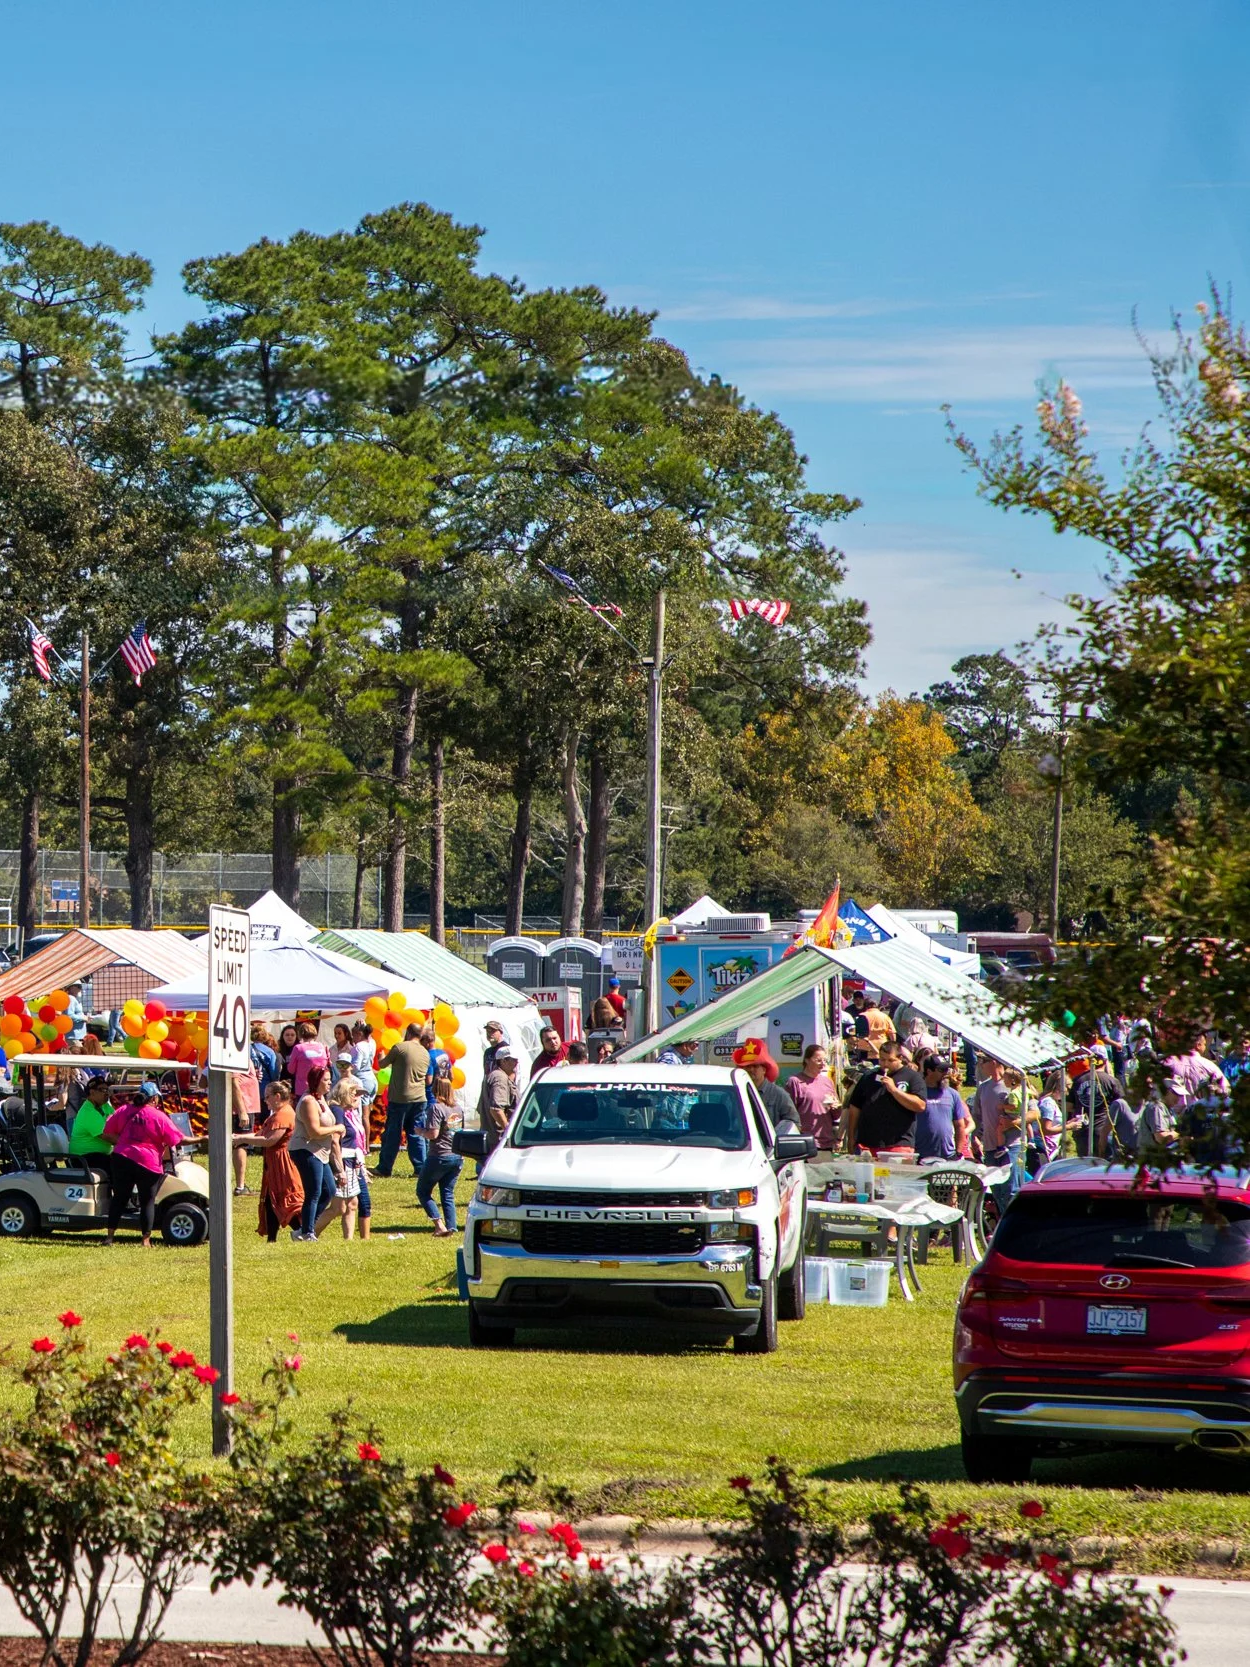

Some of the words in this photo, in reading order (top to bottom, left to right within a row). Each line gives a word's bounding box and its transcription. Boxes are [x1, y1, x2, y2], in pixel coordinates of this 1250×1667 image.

[214, 926, 247, 953] SPEED
[217, 960, 243, 986] LIMIT
[712, 967, 751, 985] Tikiz
[532, 992, 558, 1001] ATM
[214, 994, 247, 1052] 40
[595, 1083, 672, 1092] U-HAUL
[68, 1188, 83, 1198] 24
[48, 1215, 70, 1223] YAMAHA
[525, 1209, 700, 1221] CHEVROLET
